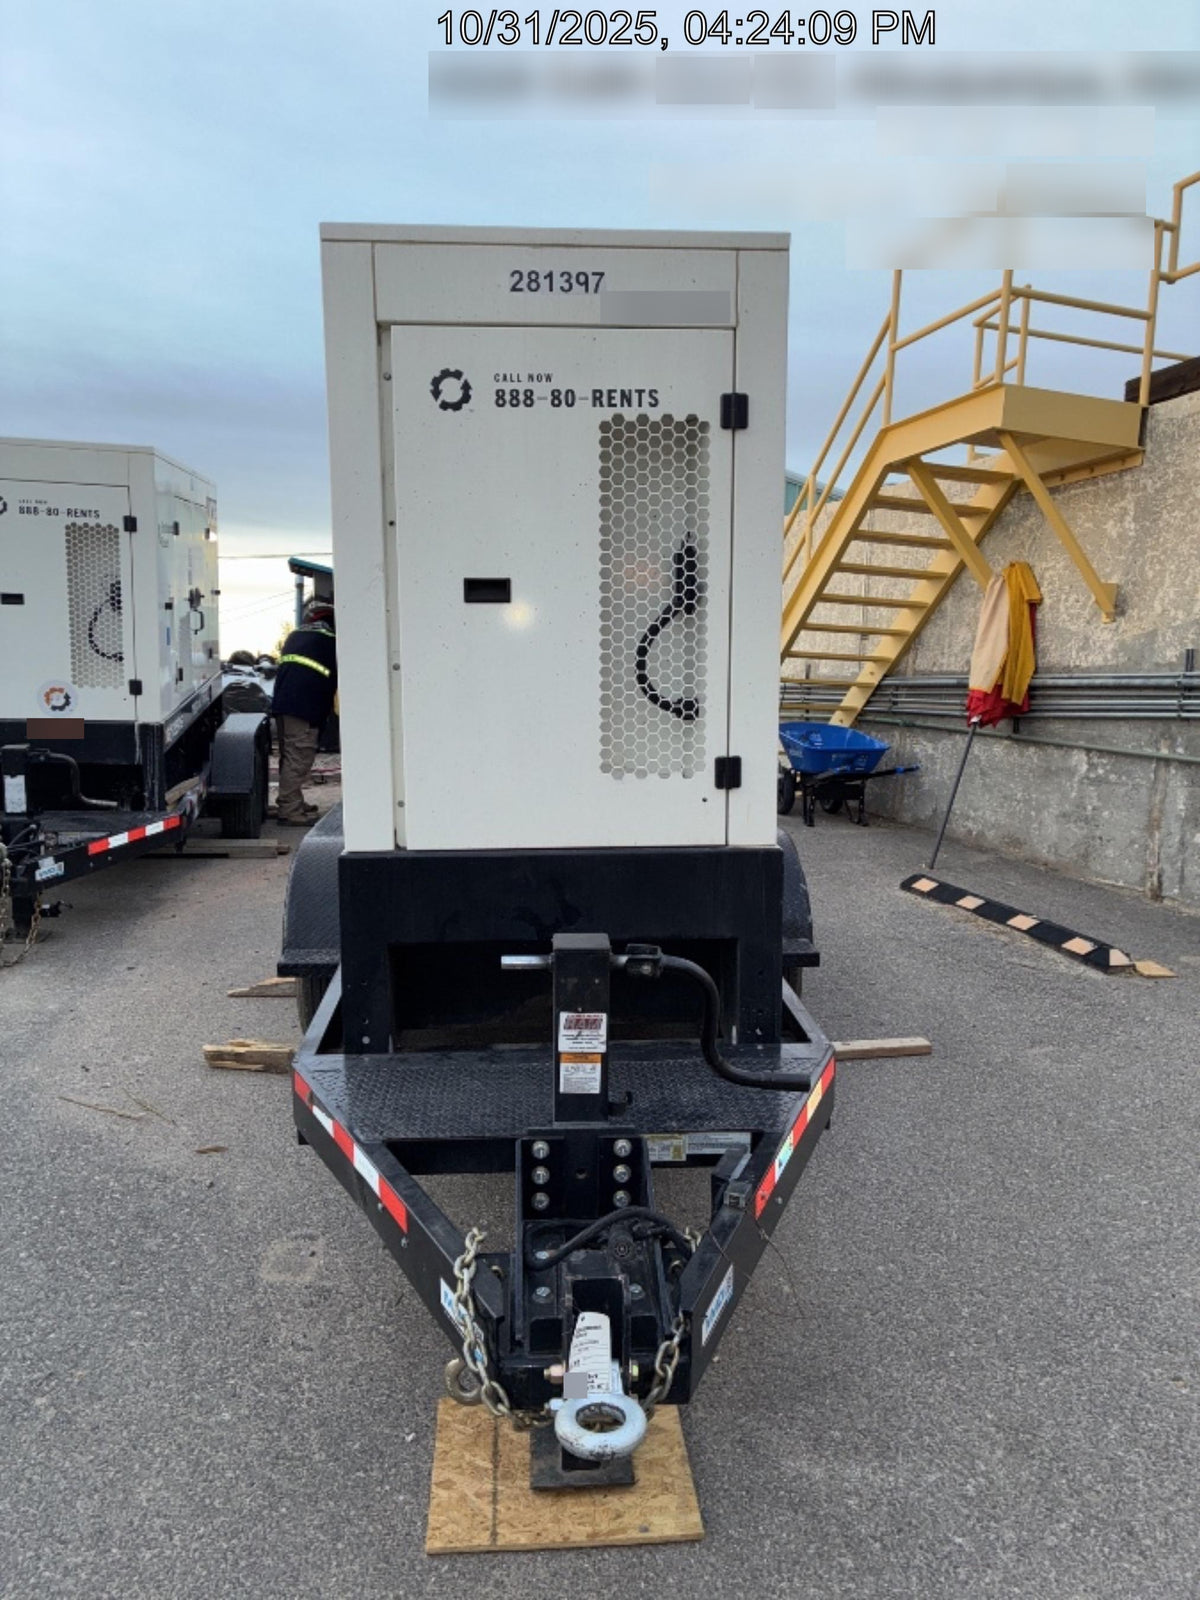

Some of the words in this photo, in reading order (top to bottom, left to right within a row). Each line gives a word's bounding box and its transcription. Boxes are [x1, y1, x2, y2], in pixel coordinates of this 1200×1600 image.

[509, 269, 606, 294] 281397
[493, 373, 523, 383] CALL
[527, 373, 554, 383] NOW
[494, 388, 660, 408] 888-80-RENTS
